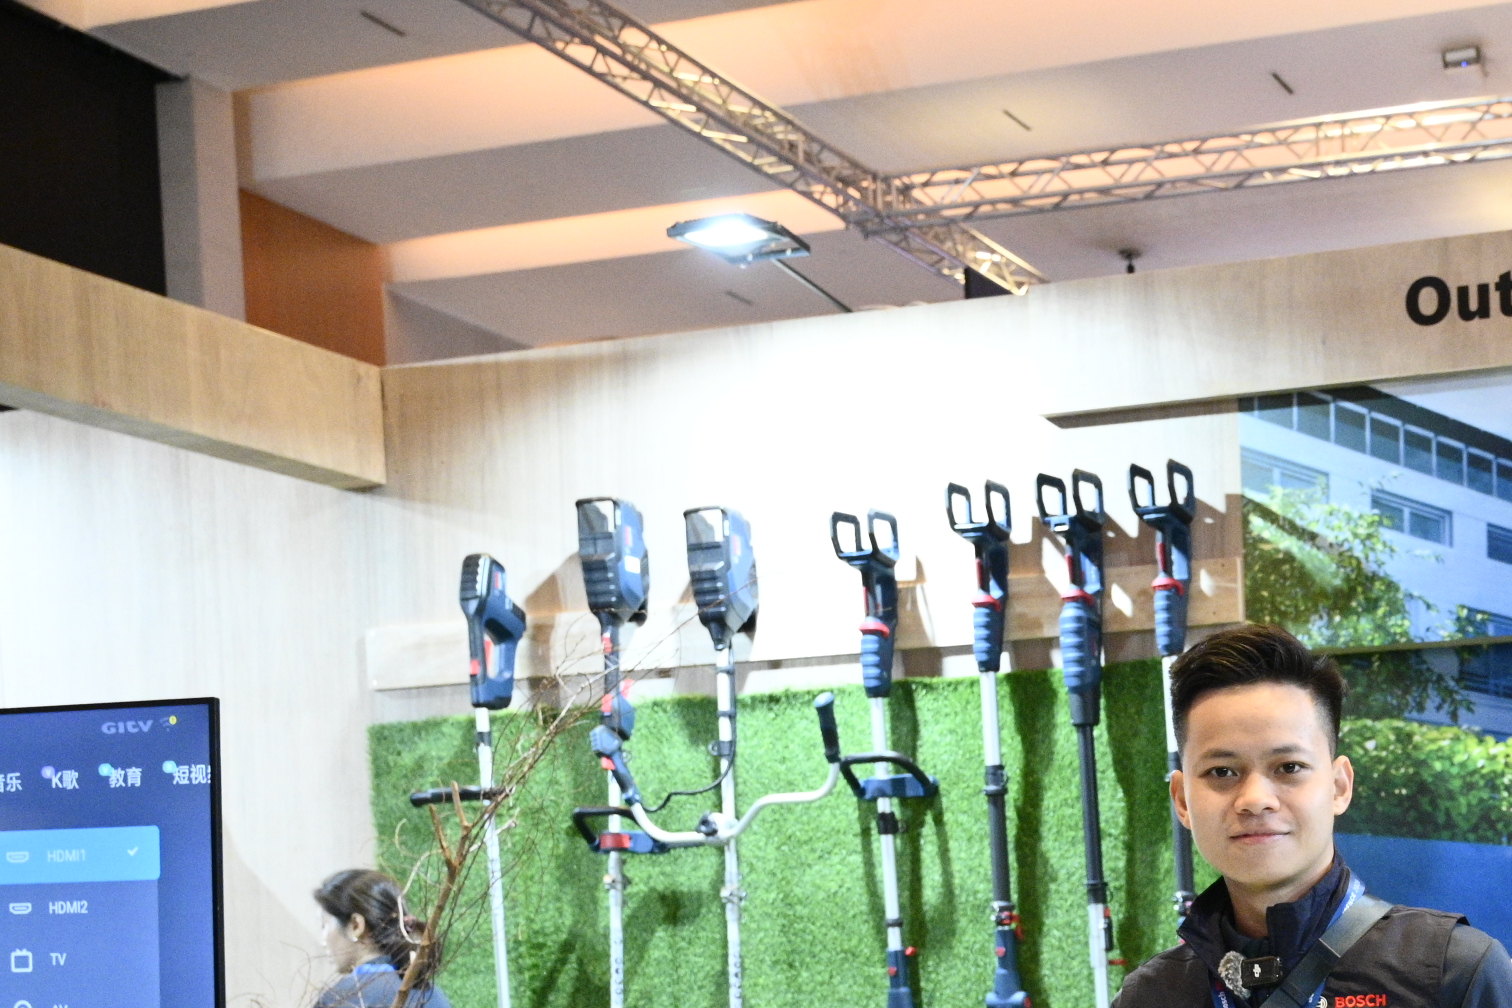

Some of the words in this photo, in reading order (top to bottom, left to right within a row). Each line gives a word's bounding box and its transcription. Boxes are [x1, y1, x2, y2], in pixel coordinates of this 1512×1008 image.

[0, 772, 23, 792] 乐
[51, 769, 79, 790] K歌
[109, 766, 142, 788] 教育
[172, 764, 211, 785] 短视
[47, 849, 86, 862] HDMI1
[49, 901, 88, 914] HDMI2
[50, 953, 66, 966] TV
[1334, 994, 1387, 1008] BOSCH
